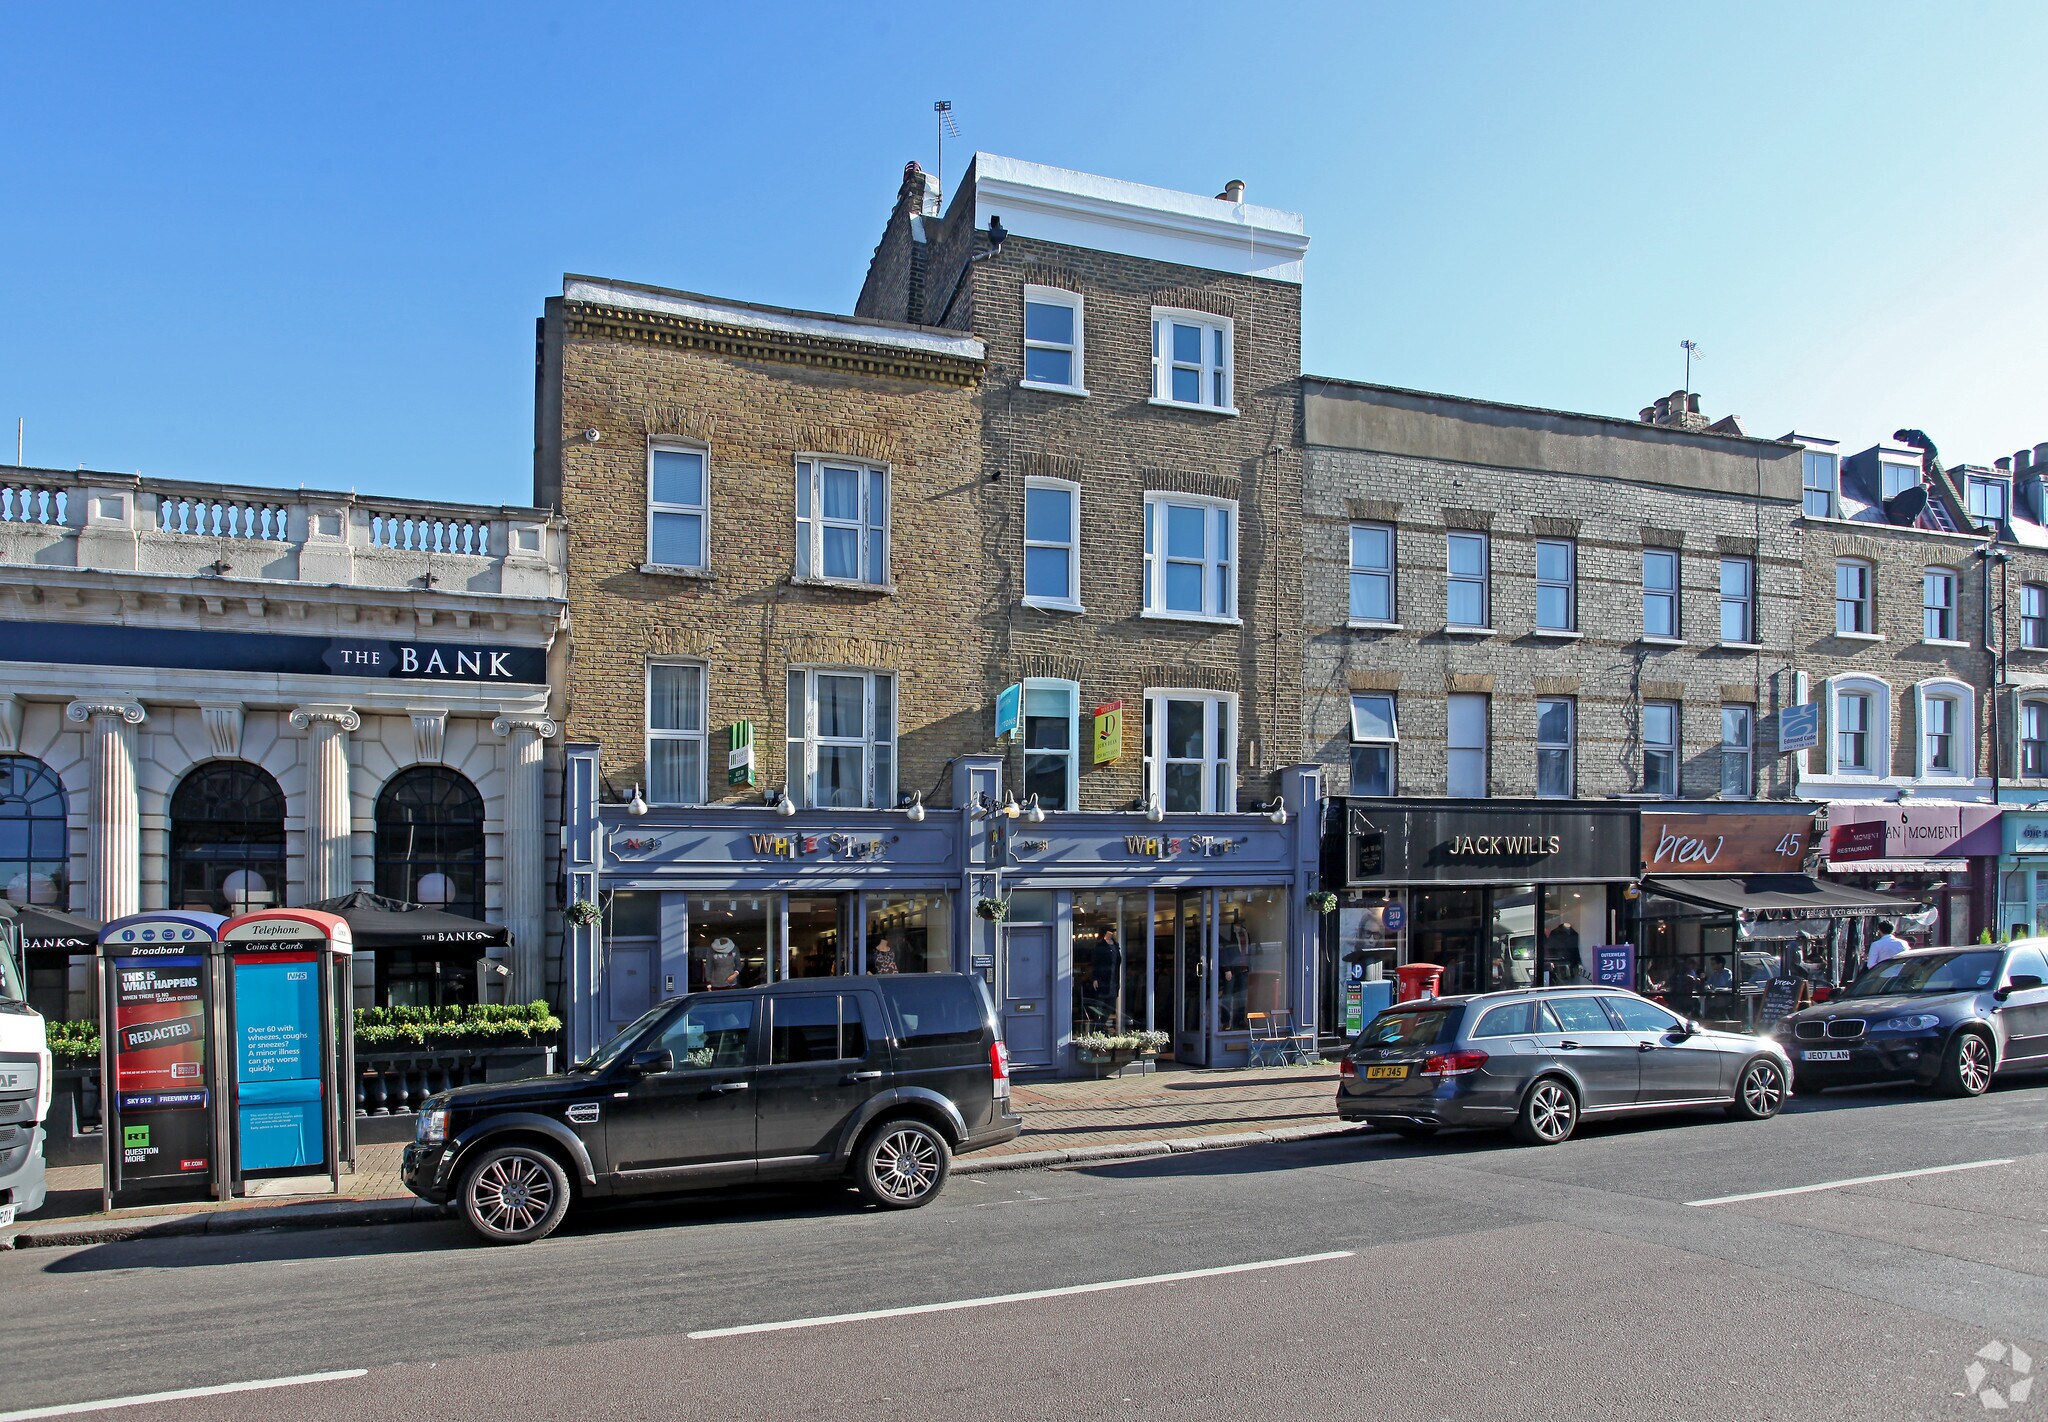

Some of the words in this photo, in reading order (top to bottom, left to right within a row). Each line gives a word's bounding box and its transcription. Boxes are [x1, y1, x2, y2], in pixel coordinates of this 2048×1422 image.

[341, 650, 380, 665] THE
[401, 647, 513, 678] BANK
[1784, 736, 1803, 745] Edmund
[1853, 832, 1879, 841] MOMENT
[1908, 825, 1959, 839] MOMENT
[1450, 835, 1502, 855] JACK
[1503, 835, 1560, 855] WILLS
[1653, 824, 1724, 864] brew
[1775, 833, 1802, 856] 45
[1837, 845, 1873, 854] RESTAURANT
[1846, 906, 1858, 914] and
[252, 925, 300, 936] Telephone
[438, 931, 475, 942] BANK
[24, 938, 66, 948] BANK
[246, 942, 268, 951] Coins
[270, 942, 278, 950] &
[279, 941, 303, 950] Cards
[131, 945, 185, 956] Broadband
[122, 971, 144, 982] THIS
[146, 971, 156, 981] IS
[288, 972, 307, 980] NHS
[123, 981, 152, 992] WHAT
[153, 977, 198, 990] HAPPENS
[1774, 978, 1797, 986] brew
[282, 1032, 308, 1040] coughs
[257, 1040, 289, 1048] sneezes?
[1807, 1051, 1828, 1060] JE07
[1830, 1051, 1849, 1060] LAN
[262, 1057, 275, 1065] get
[248, 1064, 275, 1073] quickly.
[1371, 1066, 1387, 1078] UFY
[1387, 1066, 1402, 1077] 345
[159, 1095, 188, 1103] FREEVIEW
[125, 1147, 159, 1156] QUESTION
[125, 1155, 145, 1163] MORE
